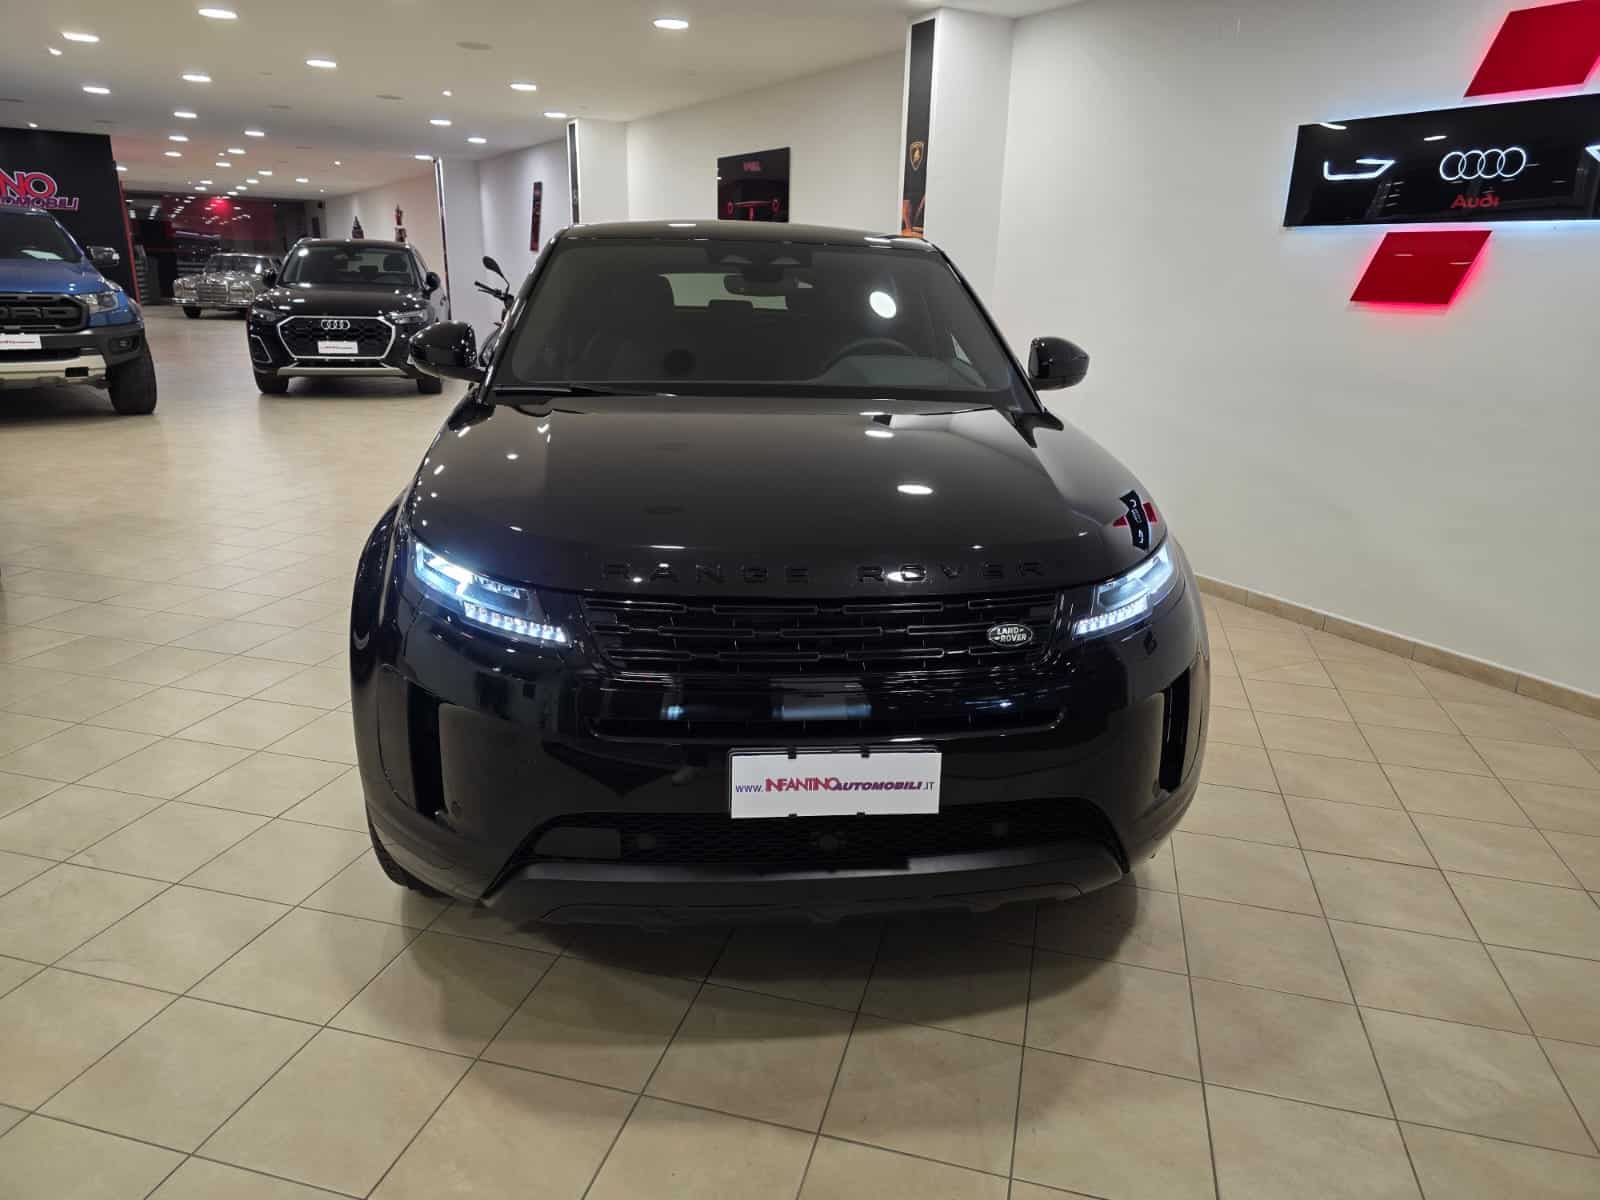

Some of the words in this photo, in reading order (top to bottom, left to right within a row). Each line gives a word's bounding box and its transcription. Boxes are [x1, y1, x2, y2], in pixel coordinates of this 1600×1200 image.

[1450, 192, 1499, 209] Audi
[0, 306, 80, 320] RD
[601, 559, 811, 584] RANGE
[856, 559, 1046, 584] ROVER
[996, 626, 1019, 635] LAND
[1000, 633, 1027, 642] ROVER
